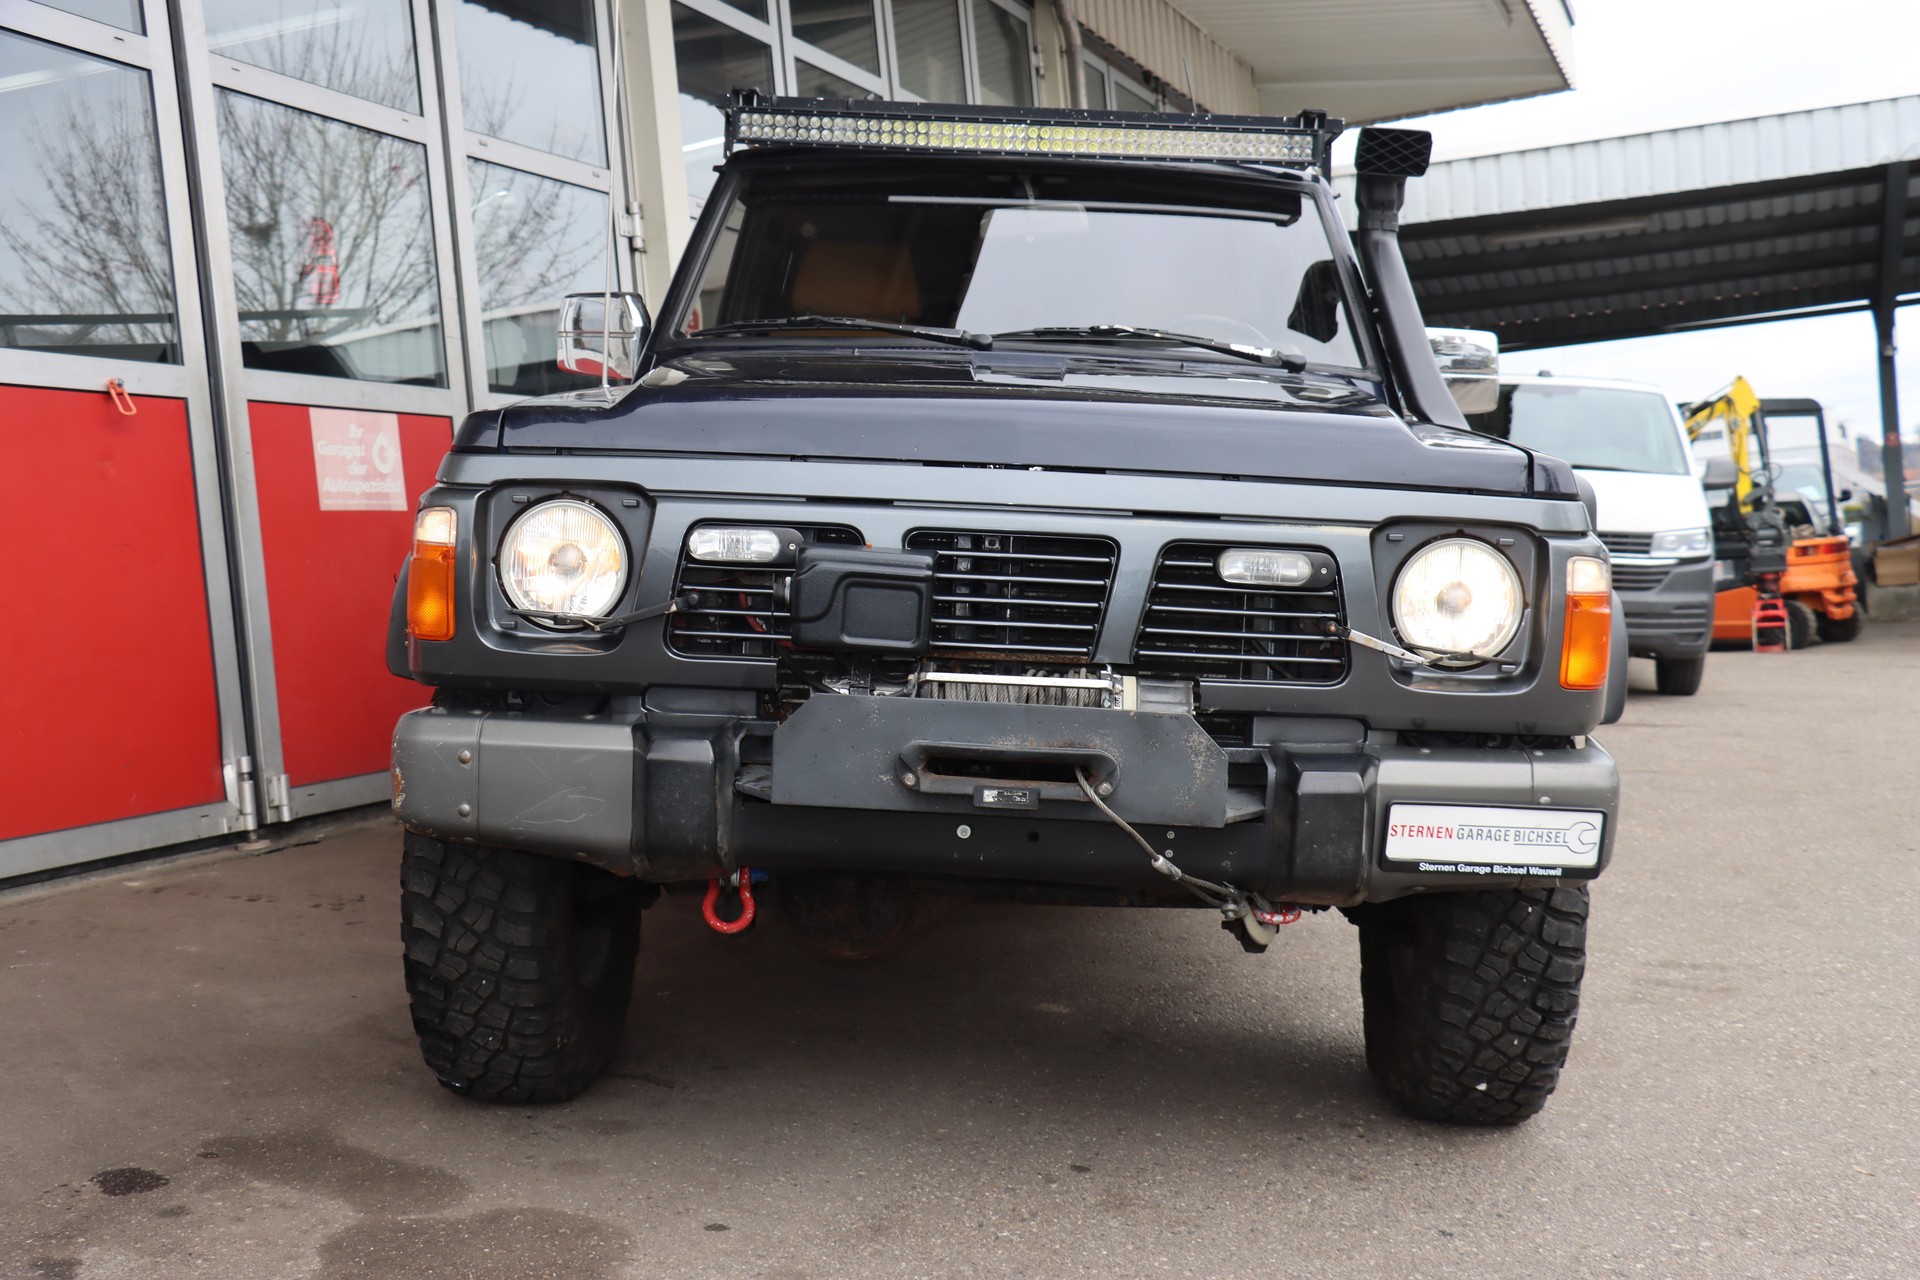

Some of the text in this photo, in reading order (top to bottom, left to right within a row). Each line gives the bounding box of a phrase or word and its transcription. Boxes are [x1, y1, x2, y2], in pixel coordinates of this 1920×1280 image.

[348, 423, 365, 438] Ihr
[317, 440, 366, 460] Garagist
[348, 461, 369, 476] der
[1390, 824, 1569, 844] STERNEN GARAGE BICHSEL
[1418, 862, 1562, 876] Sternen Garage Bichsel Wauwil
